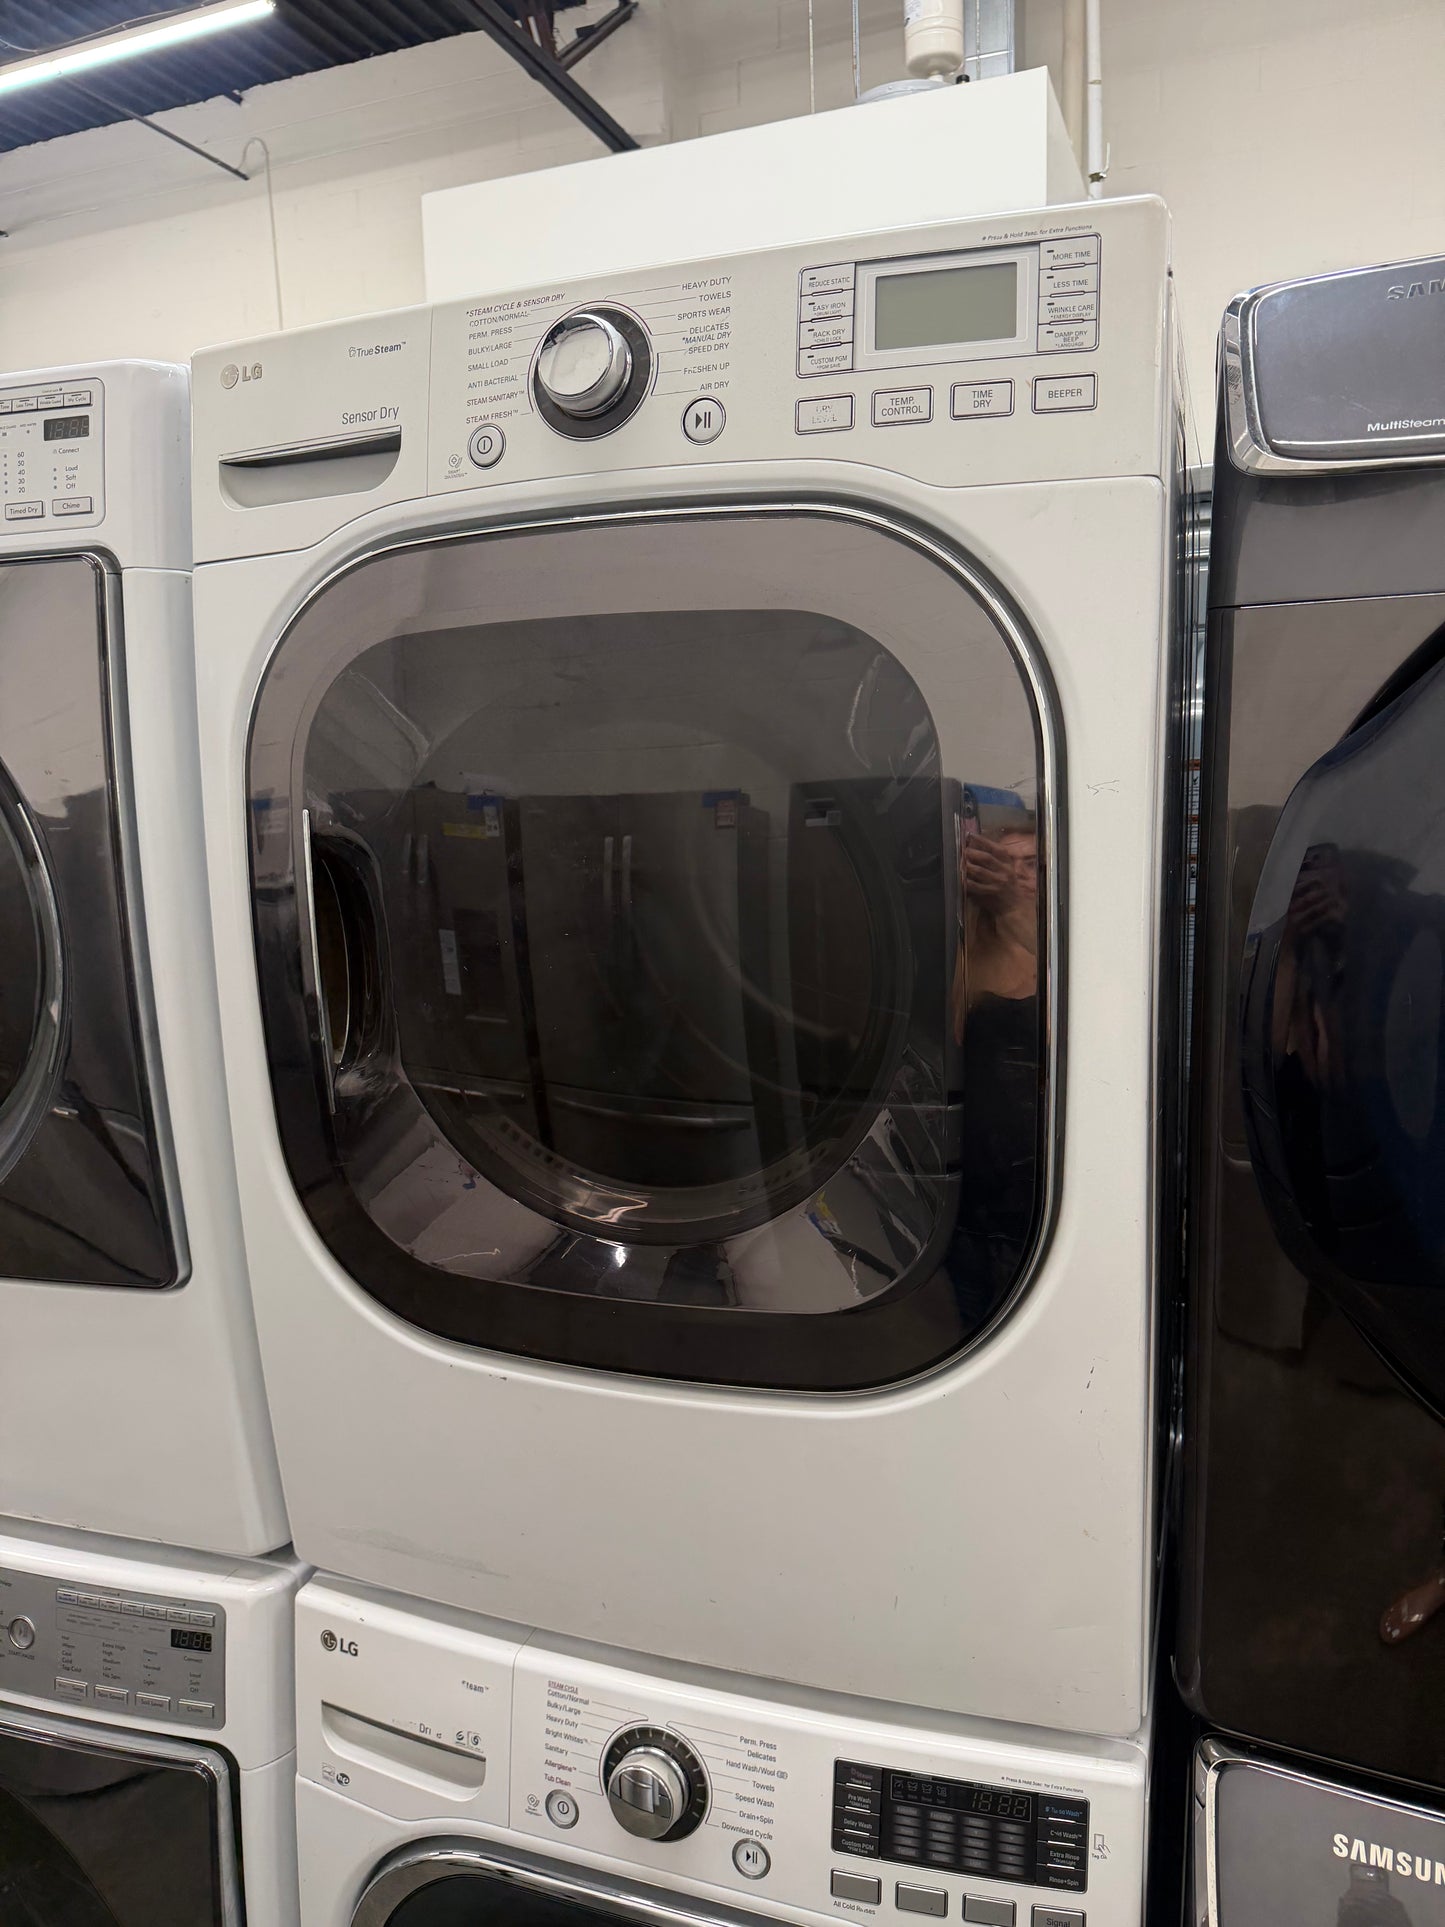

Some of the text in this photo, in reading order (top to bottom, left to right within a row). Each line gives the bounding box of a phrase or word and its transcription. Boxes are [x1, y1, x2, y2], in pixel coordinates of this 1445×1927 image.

[1065, 224, 1092, 232] Functions
[1052, 250, 1092, 260] MORE TIME
[682, 276, 732, 291] HEAVY DUTY
[808, 276, 850, 288] REDUCE STATIC
[1053, 278, 1088, 288] LESS TIME
[494, 302, 515, 312] CYCLE
[516, 300, 521, 308] &
[523, 296, 550, 308] SENSOR
[551, 292, 566, 302] DRY
[698, 290, 732, 302] TOWELS
[678, 306, 731, 320] SPORTS WEAR
[812, 304, 829, 312] EASY
[1048, 304, 1094, 314] WRINKLE CARE
[468, 326, 512, 340] PERM. PRESS
[689, 322, 730, 334] DELICATES
[813, 328, 846, 338] RACK DRY
[716, 331, 732, 340] DRY
[468, 342, 512, 356] BULKY/LARGE
[688, 342, 730, 354] SPEED DRY
[467, 358, 509, 372] SMALL LOAD
[810, 354, 848, 366] CUSTOM PGM
[241, 362, 263, 382] LG
[719, 362, 730, 371] UP
[467, 374, 519, 390] ANTI BACTERIAL
[700, 380, 730, 392] AIR DRY
[972, 390, 993, 398] TIME
[1048, 388, 1083, 398] BEEPER
[466, 398, 488, 407] STEAM
[890, 396, 914, 406] TEMP.
[973, 400, 992, 408] DRY
[342, 405, 400, 426] Sensor Dry
[881, 406, 924, 416] CONTROL
[466, 415, 490, 424] STEAM
[28, 506, 38, 514] Dry
[62, 502, 80, 510] Chime
[340, 1638, 358, 1657] LG
[548, 1689, 590, 1706] Cotton/Normal
[547, 1700, 582, 1716] Bulky/Large
[546, 1714, 578, 1729] Heavy Duty
[545, 1728, 562, 1740] Bright
[544, 1742, 569, 1756] Sanitary
[740, 1736, 777, 1750] Perm. Press
[748, 1750, 776, 1762] Delicates
[726, 1759, 776, 1776] Hand Wash/Wool
[544, 1774, 572, 1787] Tub Clean
[752, 1780, 775, 1792] Towels
[735, 1792, 774, 1808] Speed Wash
[856, 1796, 872, 1804] Wash
[739, 1810, 774, 1824] Drain+Spin
[844, 1818, 872, 1829] Delay Wash
[722, 1822, 773, 1840] Download Cycle
[842, 1838, 874, 1851] Custom PGM
[1050, 1850, 1080, 1860] Extra Rinse
[834, 1900, 842, 1908] All
[842, 1902, 856, 1910] Cold
[1046, 1918, 1071, 1927] Signal
